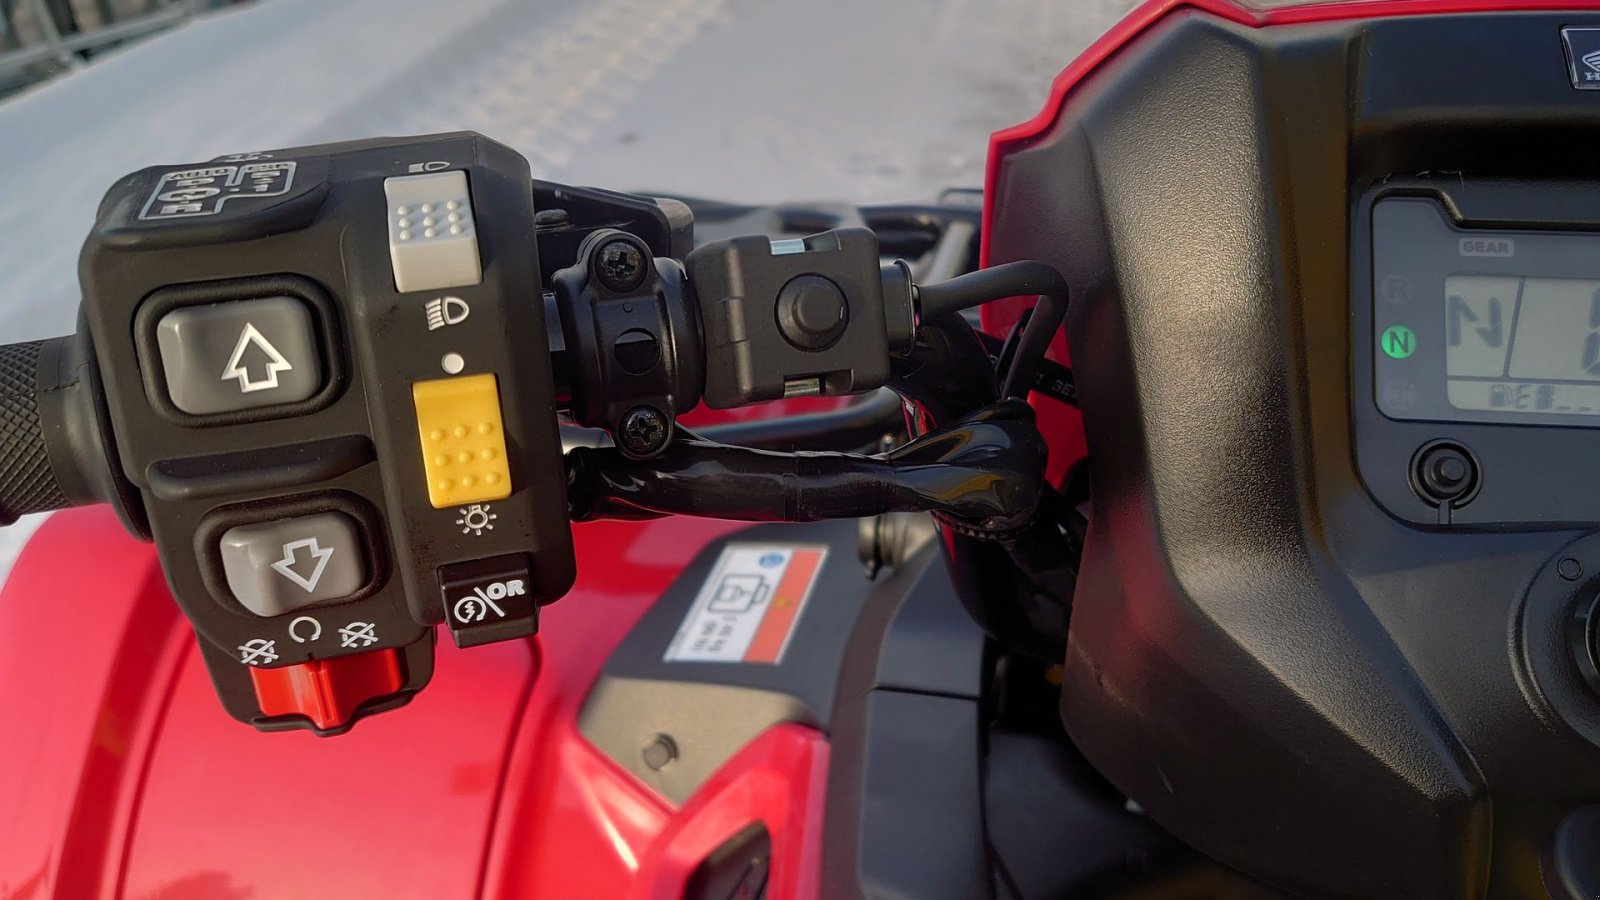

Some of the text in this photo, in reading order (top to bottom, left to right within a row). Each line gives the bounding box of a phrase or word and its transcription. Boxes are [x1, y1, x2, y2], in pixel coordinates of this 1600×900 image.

[170, 168, 229, 180] AUTO
[175, 177, 215, 188] D
[1463, 240, 1510, 254] GEAR
[1447, 295, 1504, 349] N
[1389, 330, 1409, 354] N
[486, 579, 526, 600] OR
